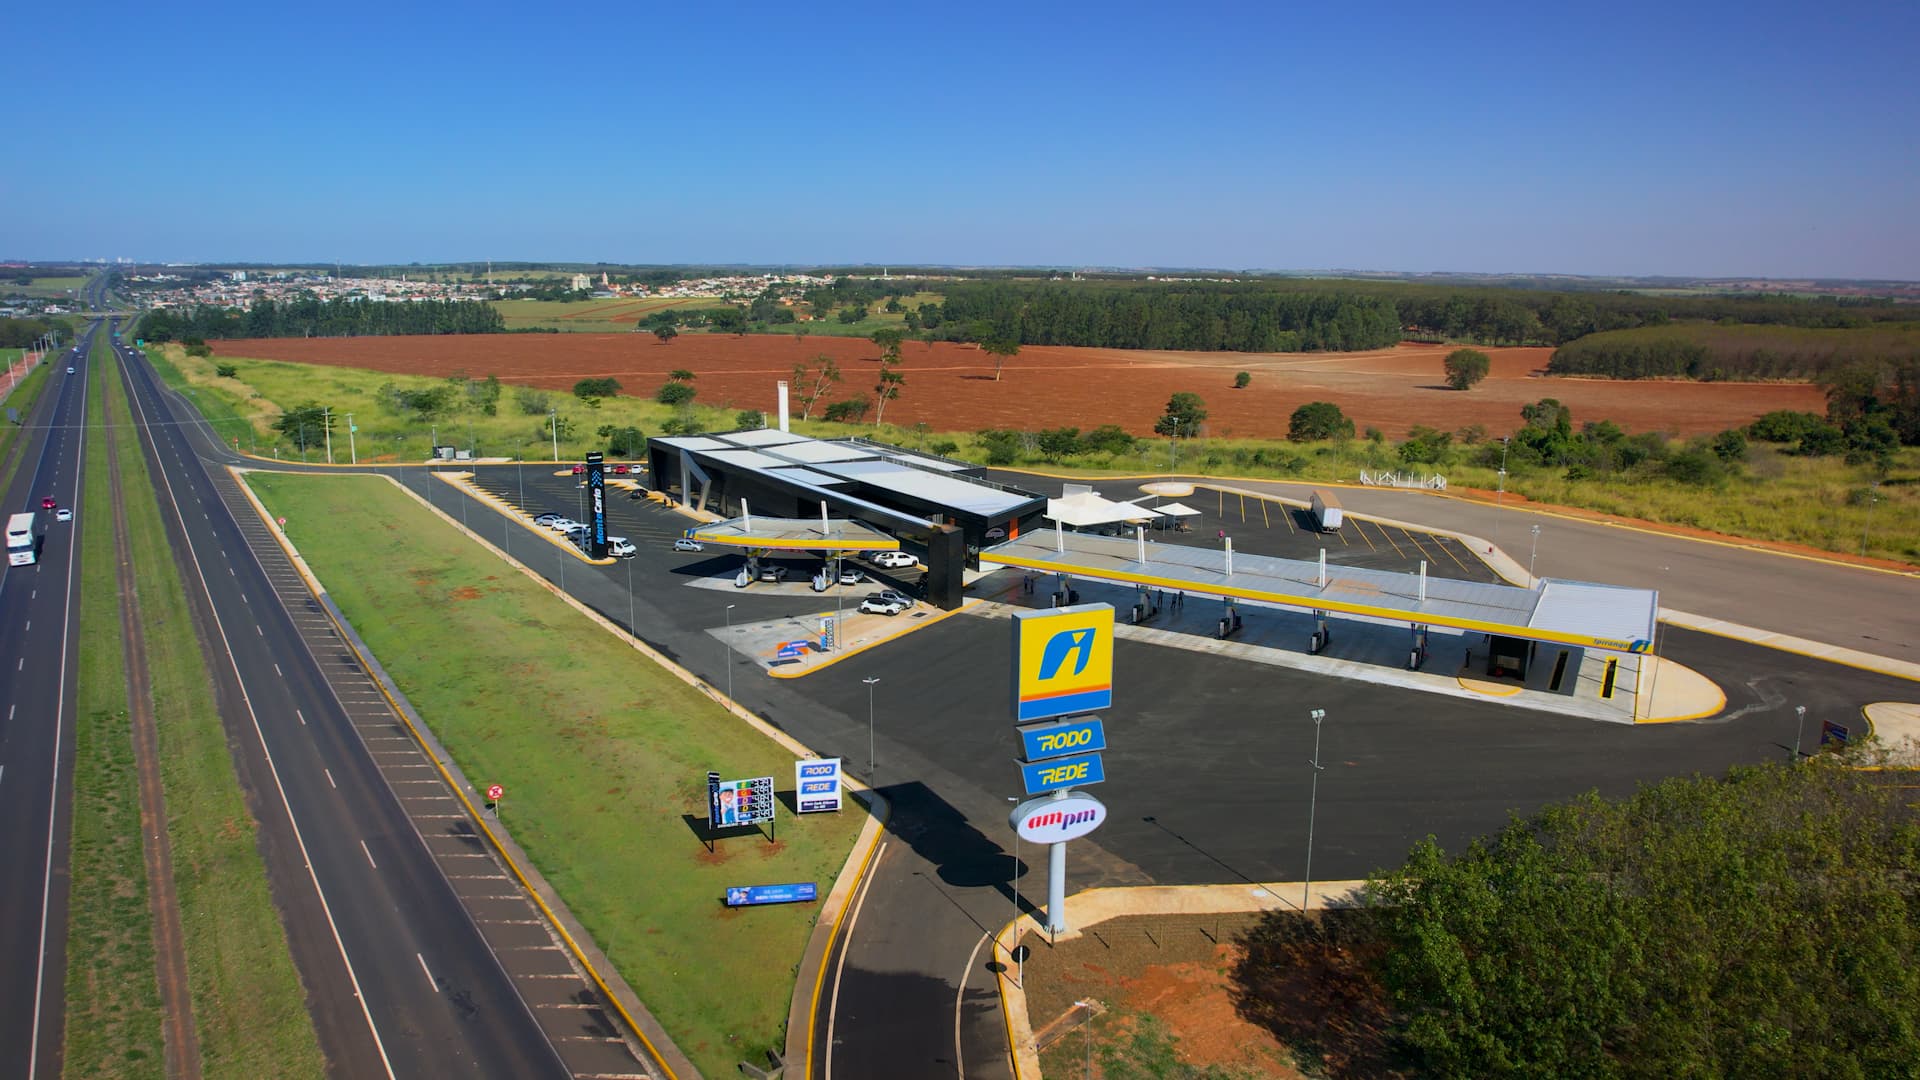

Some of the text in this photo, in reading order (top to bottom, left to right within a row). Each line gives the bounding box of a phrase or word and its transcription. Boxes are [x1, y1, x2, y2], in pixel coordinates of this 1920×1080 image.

[1037, 729, 1092, 751] RODO
[803, 766, 832, 775] RODO
[1038, 762, 1089, 785] REDE
[804, 782, 831, 791] REDE
[1028, 809, 1095, 830] ampm
